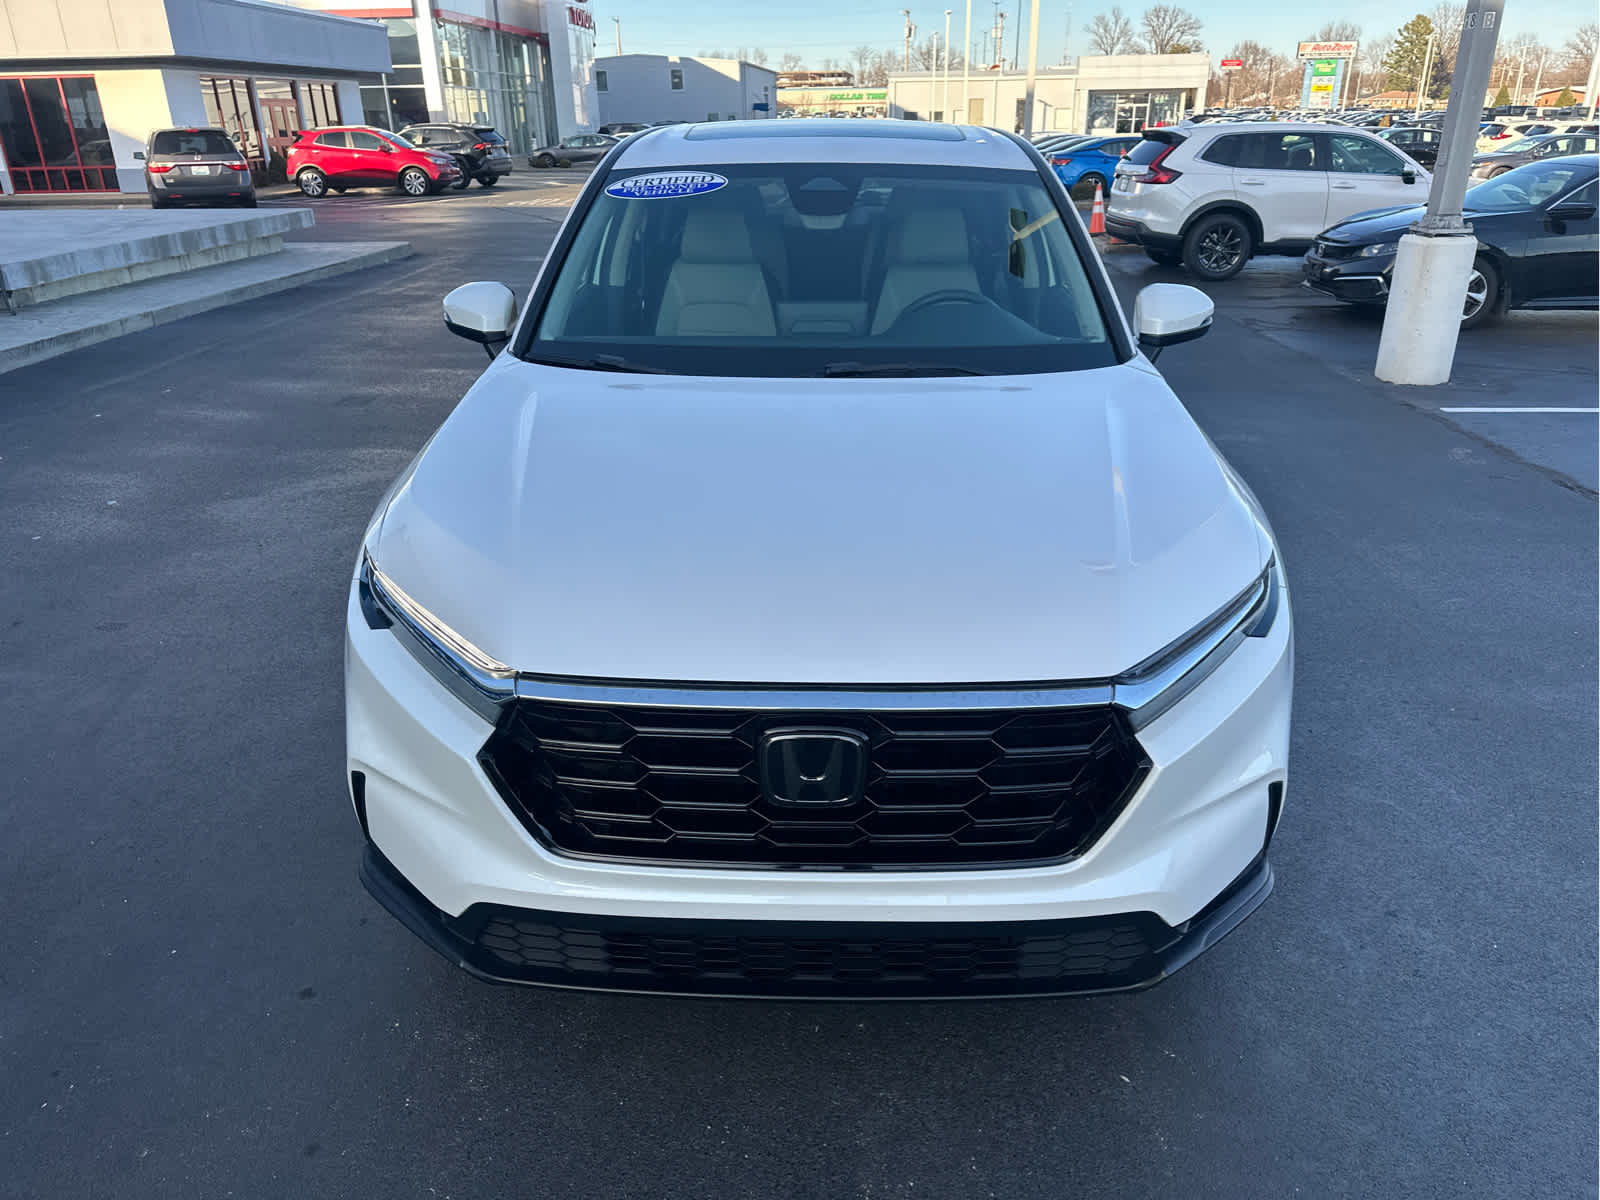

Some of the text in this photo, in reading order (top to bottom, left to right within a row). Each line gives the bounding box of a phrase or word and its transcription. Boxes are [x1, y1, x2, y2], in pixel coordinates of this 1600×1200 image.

[1312, 43, 1353, 51] AutoZone
[830, 93, 863, 101] DOLLAR
[621, 176, 715, 188] CERTIFIED
[623, 183, 709, 193] PRE-OWNED
[634, 186, 695, 196] VEHICLE
